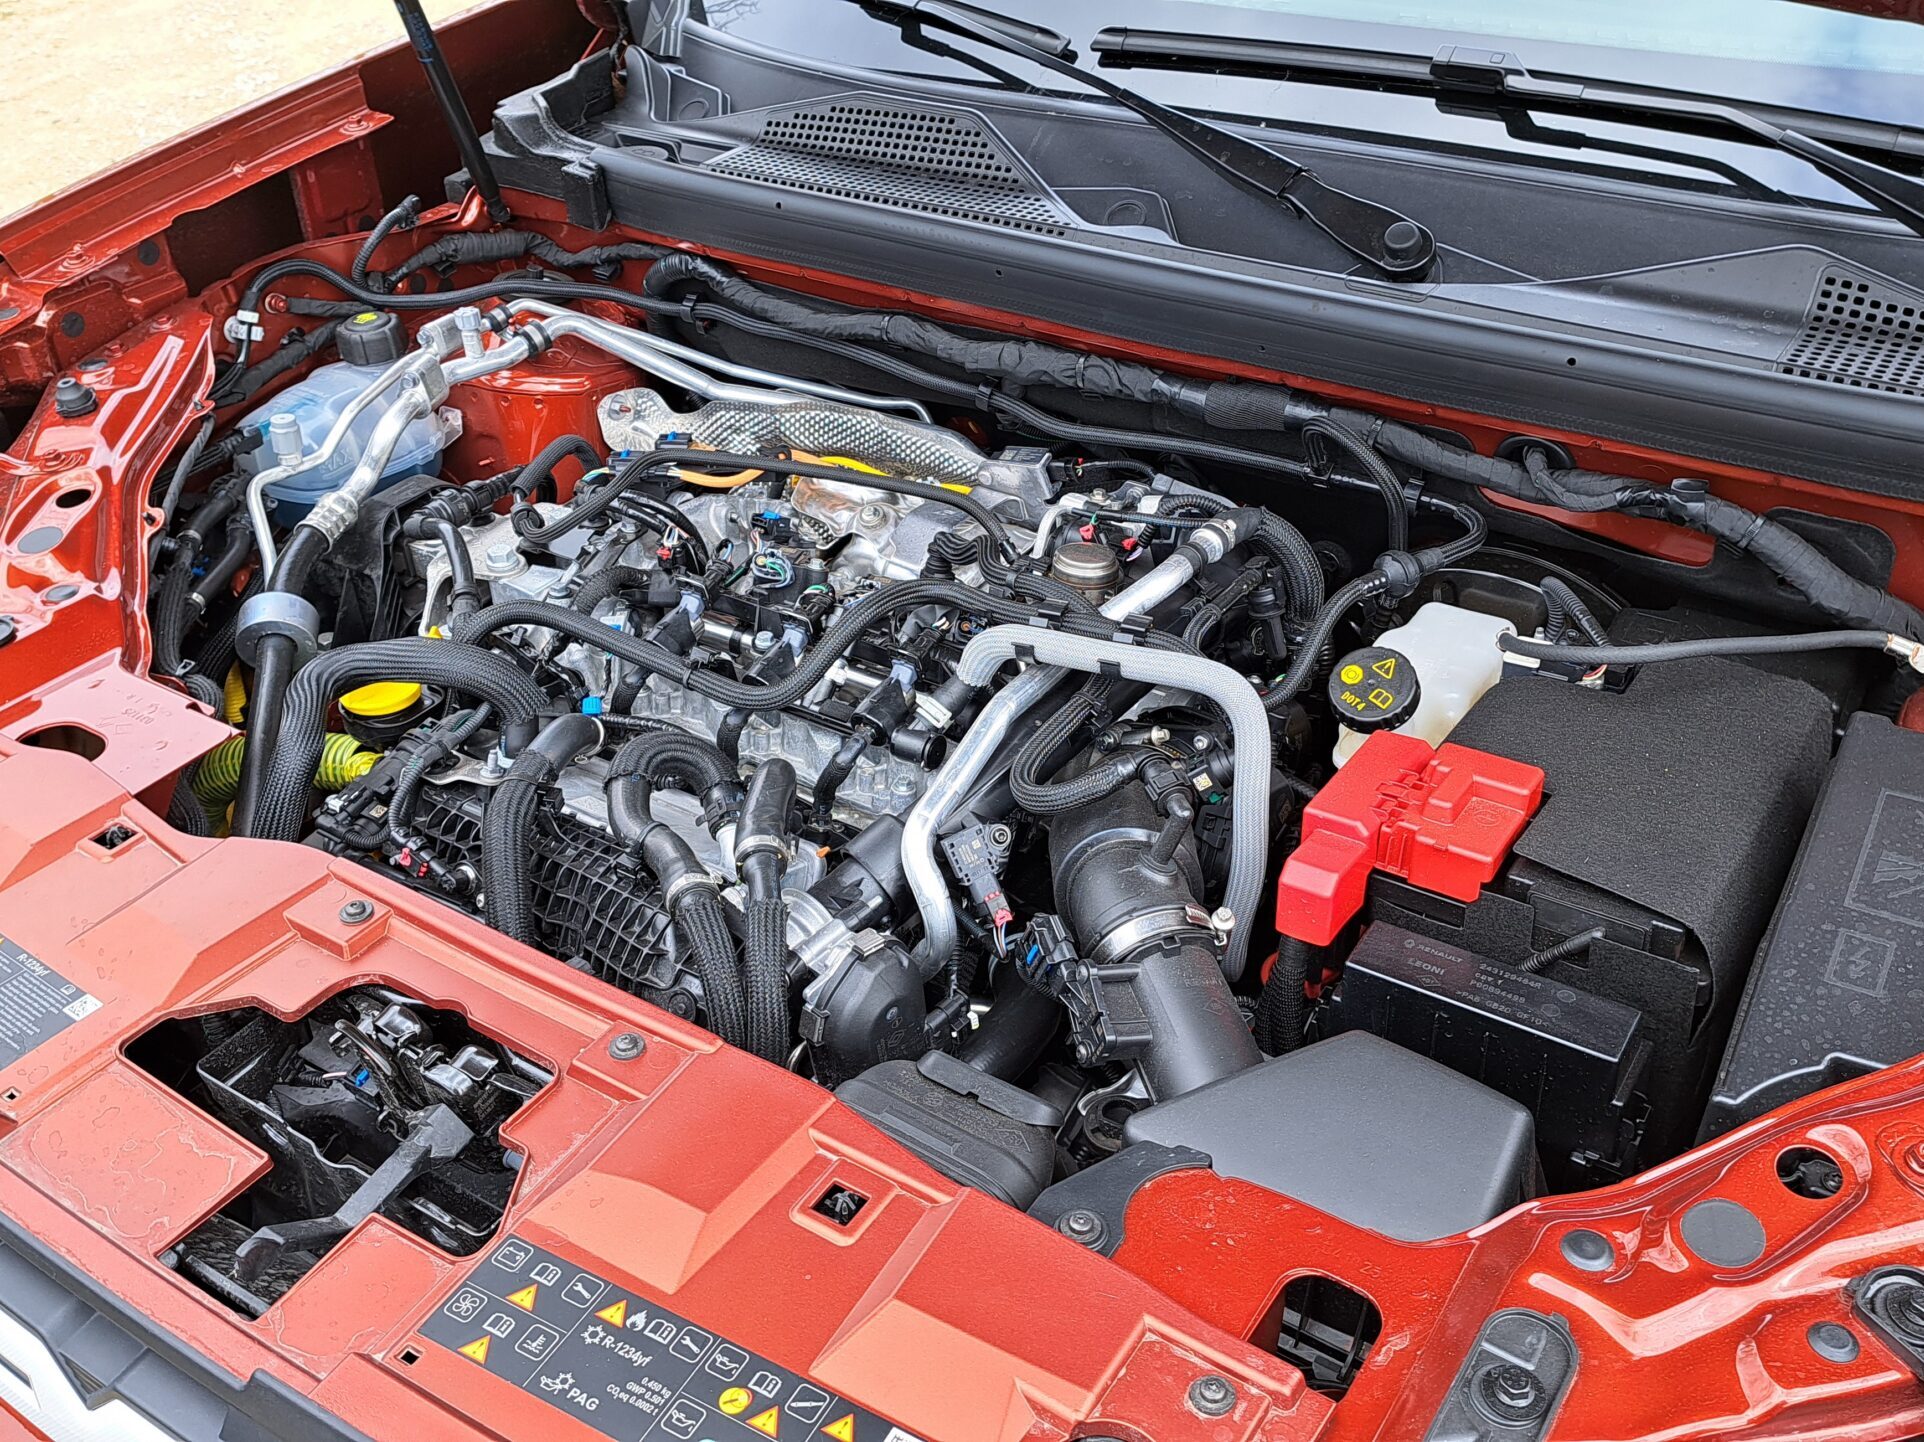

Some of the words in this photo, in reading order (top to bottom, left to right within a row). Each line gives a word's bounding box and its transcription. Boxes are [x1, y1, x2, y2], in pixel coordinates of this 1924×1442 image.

[16, 952, 51, 977] R-1234yf
[1407, 957, 1447, 976] LEONI
[601, 1335, 653, 1367] R-1234yf
[567, 1386, 600, 1411] PAG
[625, 1381, 646, 1396] GWP
[644, 1391, 666, 1407] 0.501
[641, 1376, 662, 1392] 0.450
[660, 1386, 672, 1399] kg
[629, 1396, 654, 1414] 0.0002
